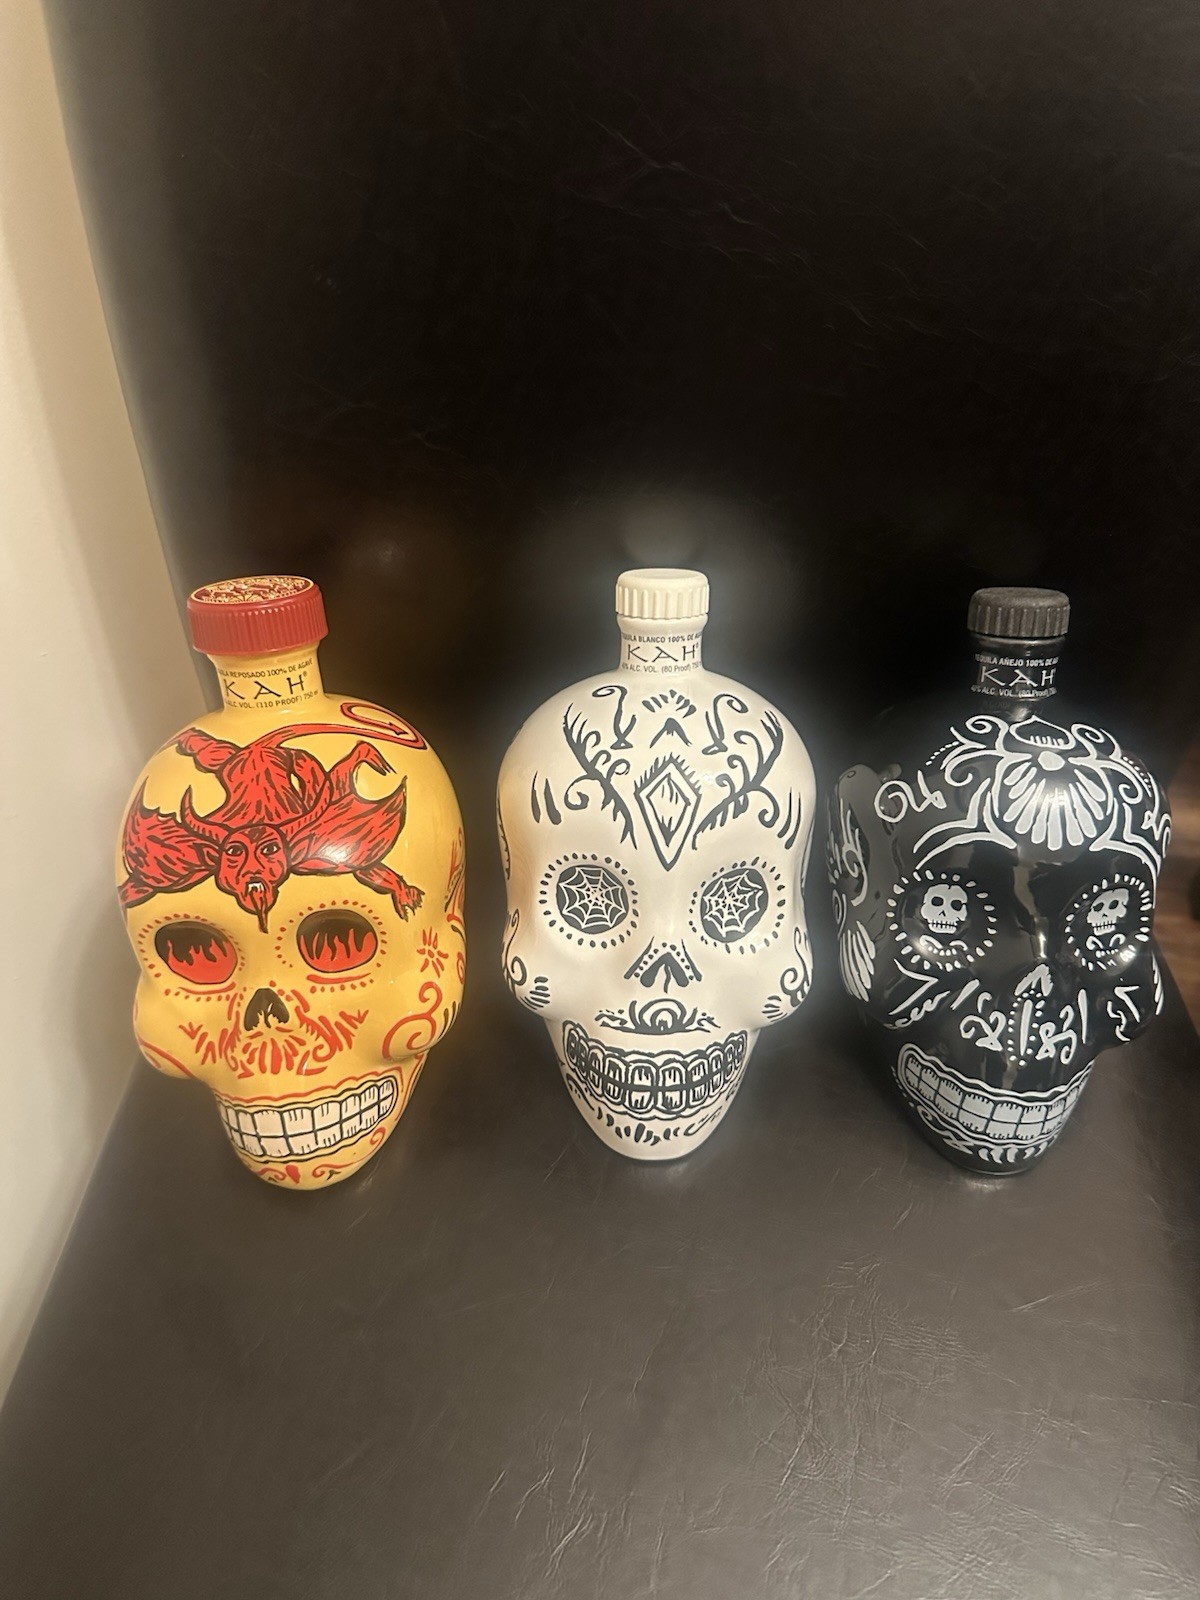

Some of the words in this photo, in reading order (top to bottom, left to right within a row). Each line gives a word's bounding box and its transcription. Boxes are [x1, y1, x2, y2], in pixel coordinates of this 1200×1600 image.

[638, 635, 666, 644] BLANCO
[668, 635, 686, 643] 100%
[627, 643, 695, 663] KAH
[230, 670, 266, 679] REPOSADO
[267, 668, 287, 677] 100%
[288, 664, 297, 673] DE
[298, 657, 313, 670] AGAVE
[661, 665, 673, 674] (80
[998, 656, 1024, 667] AÑEJO
[1025, 658, 1044, 668] 100%
[980, 665, 1054, 687] KAH
[223, 674, 305, 700] KAH
[256, 701, 273, 709] (110
[275, 695, 302, 708] PROOF)
